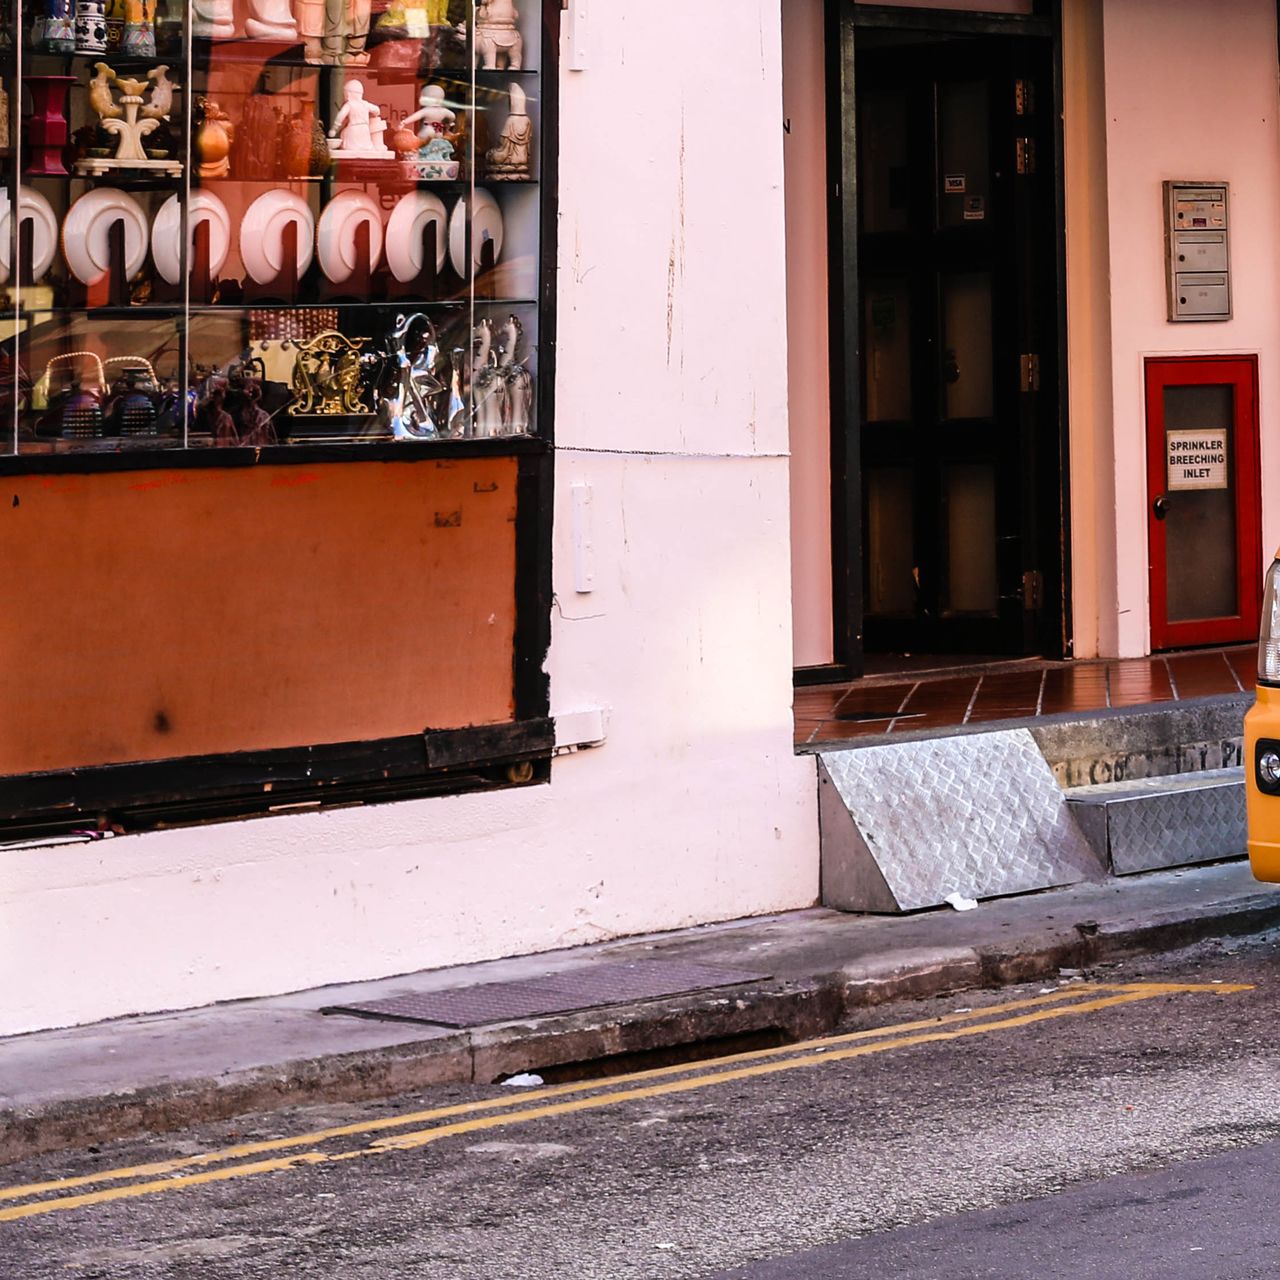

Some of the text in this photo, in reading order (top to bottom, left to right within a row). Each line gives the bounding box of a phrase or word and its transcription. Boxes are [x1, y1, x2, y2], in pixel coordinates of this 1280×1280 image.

[1170, 440, 1223, 452] SPRINKLER
[1169, 453, 1225, 466] BREECHING
[1183, 468, 1211, 479] INLET
